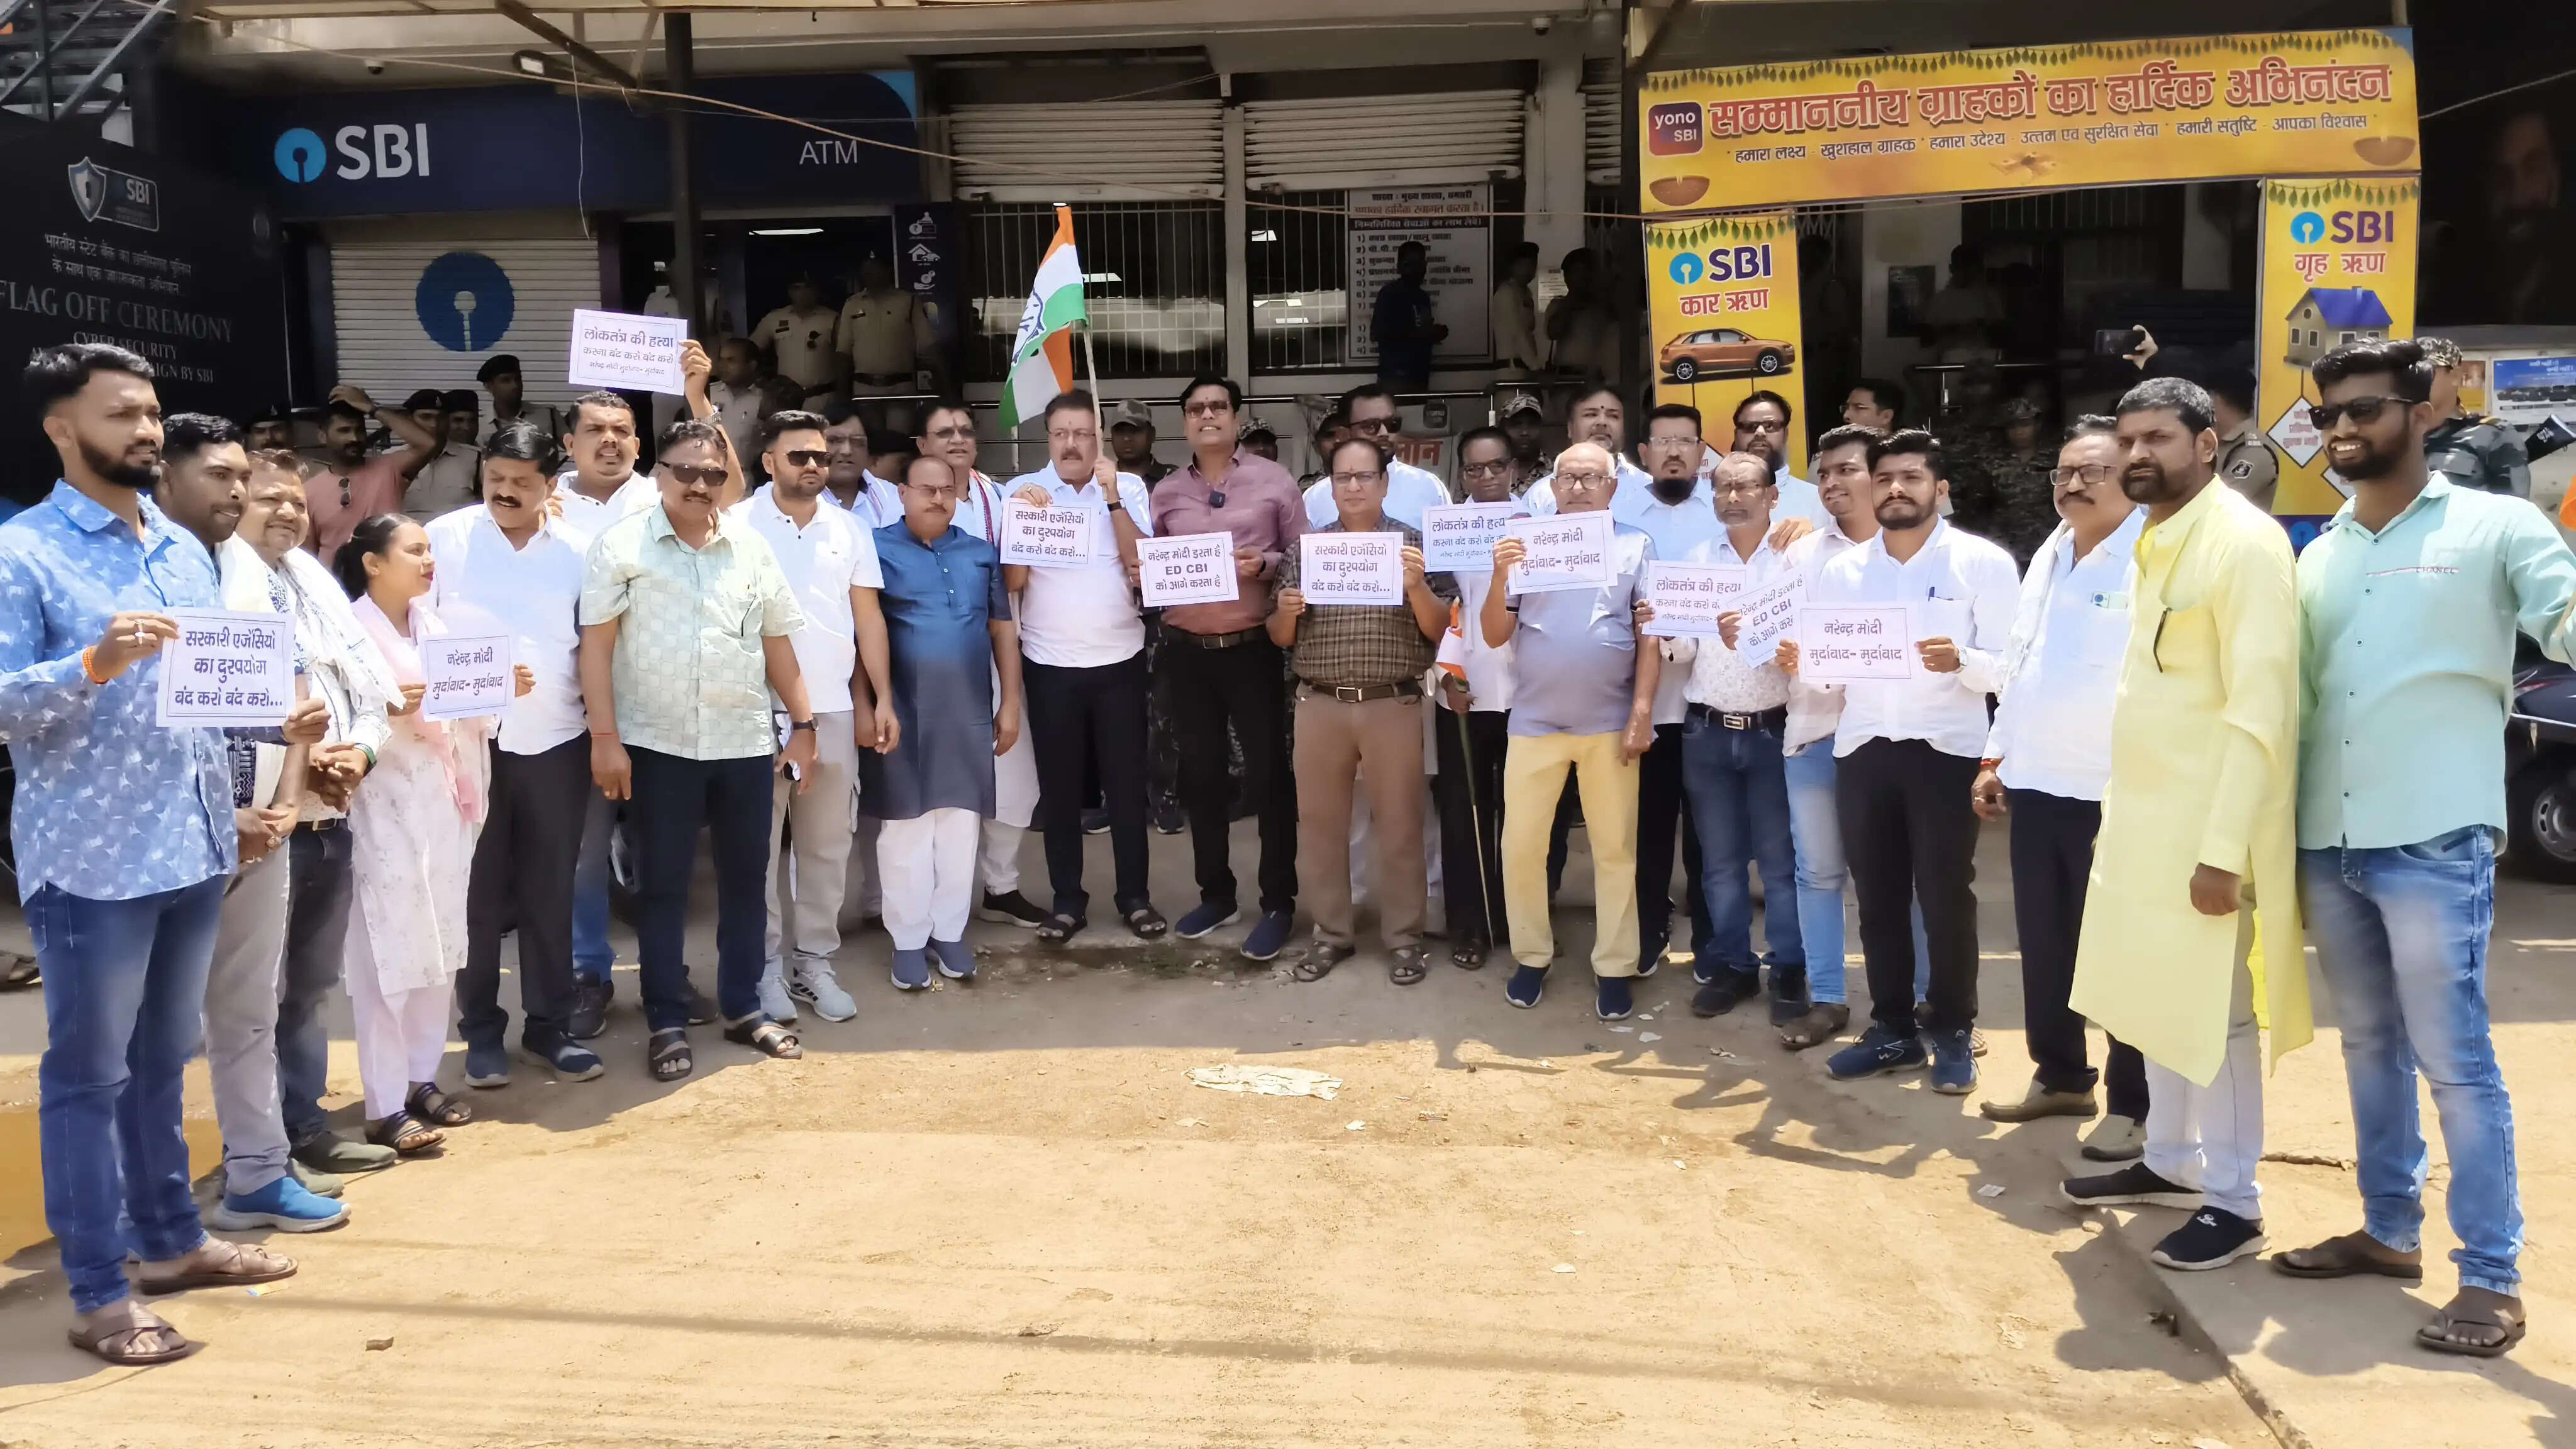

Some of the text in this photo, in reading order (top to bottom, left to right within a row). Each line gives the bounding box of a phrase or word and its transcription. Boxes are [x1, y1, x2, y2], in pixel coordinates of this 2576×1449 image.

[1708, 57, 2392, 136] सम्माननीय ग्राहकों का हार्दिक अभिनंदन
[1654, 109, 1696, 129] yono
[1674, 128, 1697, 142] SBI
[1735, 147, 1770, 164] हमारा
[1775, 145, 1806, 160] लक्ष्य
[1821, 142, 1873, 160] खुशहाल
[1877, 138, 1916, 153] ग्राहक
[1929, 134, 1966, 150] हमारा
[2021, 129, 2057, 144] उत्तम
[2084, 121, 2129, 143] सुरक्षित
[2133, 120, 2159, 137] सेवा
[2176, 117, 2212, 135] हमारी
[2217, 114, 2258, 136] संतुष्टि
[2272, 117, 2316, 131] आपका
[2320, 112, 2367, 129] विश्वास
[335, 123, 430, 180] SBI
[799, 140, 857, 165] ATM
[126, 178, 150, 205] SBI
[2330, 211, 2394, 243] SBI
[1709, 244, 1772, 282] SBI
[2294, 252, 2387, 282] गृह ऋण
[1679, 288, 1770, 316] कार ऋण
[65, 292, 111, 323] OFF
[117, 301, 232, 343] CEREMONY
[584, 326, 674, 348] लोकतंत्र की हत्या
[624, 351, 641, 361] करो
[657, 353, 674, 364] करो
[196, 369, 214, 383] SBI
[1016, 509, 1047, 522] सरकारी
[1432, 516, 1507, 531] लोकतंत्र की हत्य
[1023, 526, 1036, 535] का
[1562, 527, 1583, 542] मोदी
[1026, 543, 1042, 554] करो
[1172, 547, 1191, 559] मोदी
[1192, 548, 1213, 558] डरता
[1314, 542, 1348, 555] सरकारी
[1165, 563, 1208, 575] ED CBI
[1323, 562, 1336, 572] का
[1155, 579, 1167, 591] को
[1170, 577, 1188, 590] आगे
[1190, 578, 1213, 587] करता
[1327, 580, 1344, 592] करो
[1657, 577, 1696, 591] लोकतंत्र
[1699, 577, 1714, 592] की
[1753, 598, 1792, 626] ED CBI
[1824, 618, 1882, 636] नरेन्द्र मोदी
[186, 626, 230, 647] सरकारी
[473, 647, 493, 663] मोदी
[194, 658, 214, 674] का
[197, 687, 221, 706] करो
